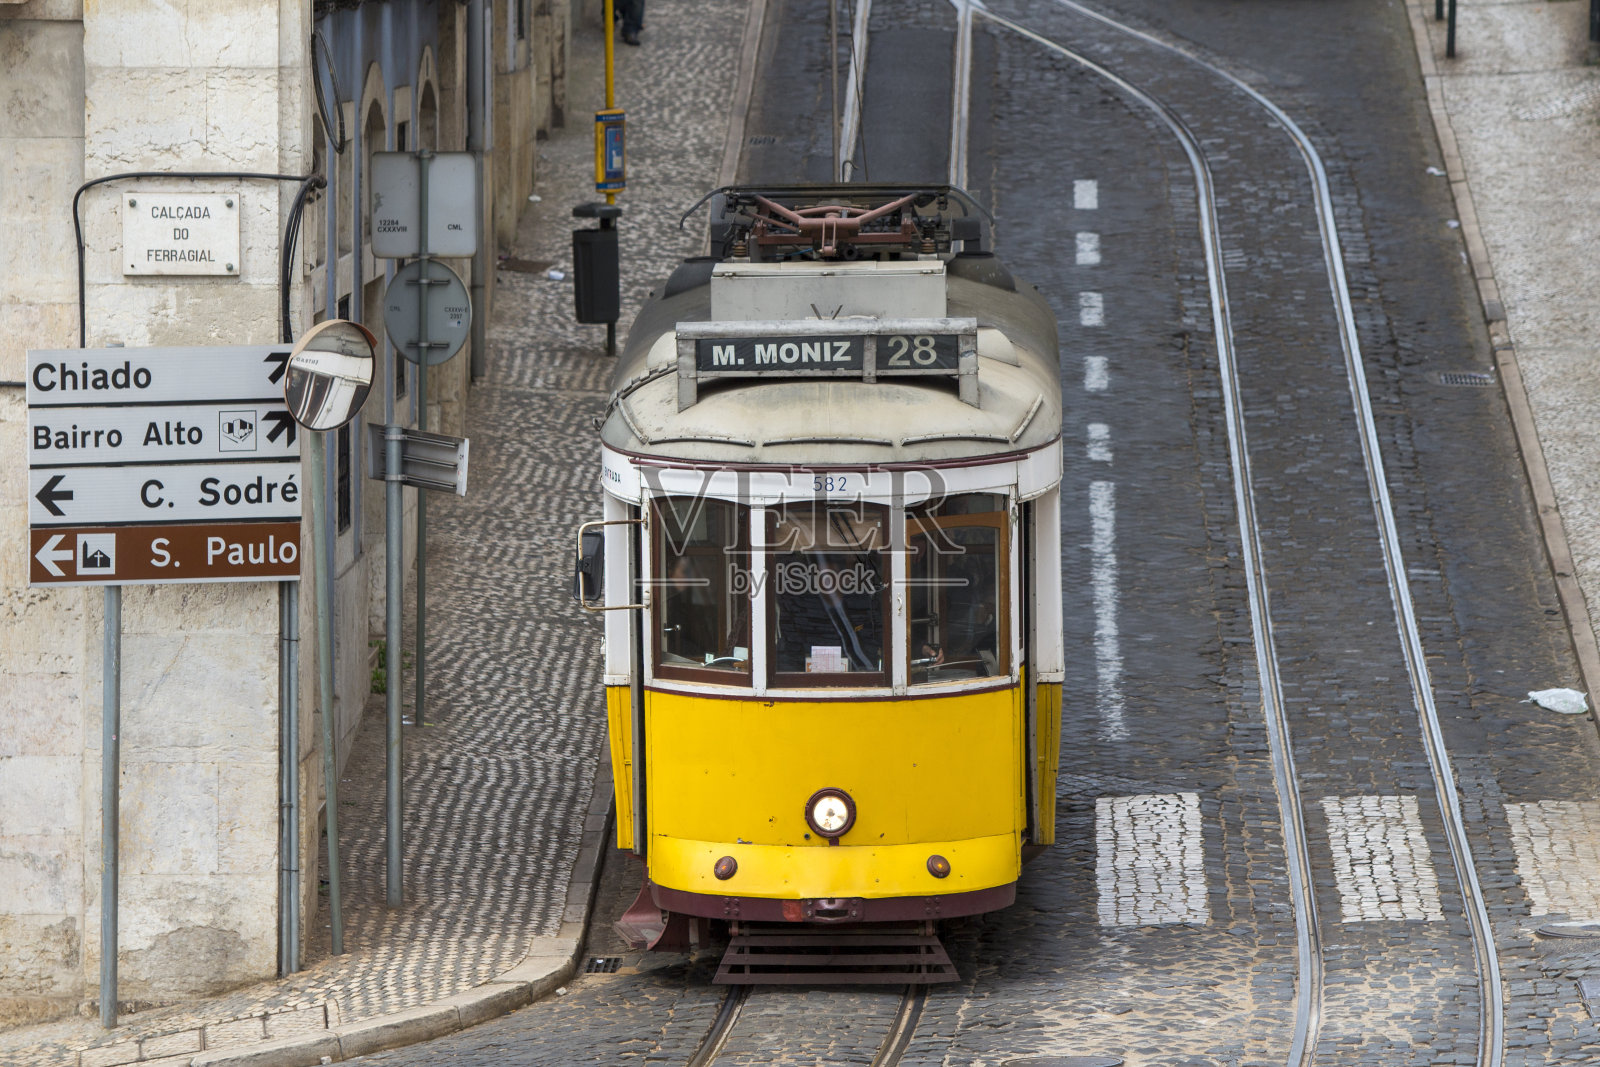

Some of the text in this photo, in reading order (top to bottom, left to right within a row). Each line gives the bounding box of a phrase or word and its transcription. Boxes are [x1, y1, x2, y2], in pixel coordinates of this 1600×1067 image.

[151, 206, 211, 220] CALÇADA
[173, 228, 189, 240] DO
[447, 223, 463, 231] CML
[147, 249, 216, 262] FERRAGIAL
[712, 341, 852, 366] M. MONIZ
[887, 334, 937, 366] 28
[32, 360, 152, 392] Chiado
[33, 421, 203, 450] Bairro Alto
[140, 474, 299, 509] C. Sodré
[813, 476, 847, 492] 582
[150, 534, 298, 568] S. Paulo
